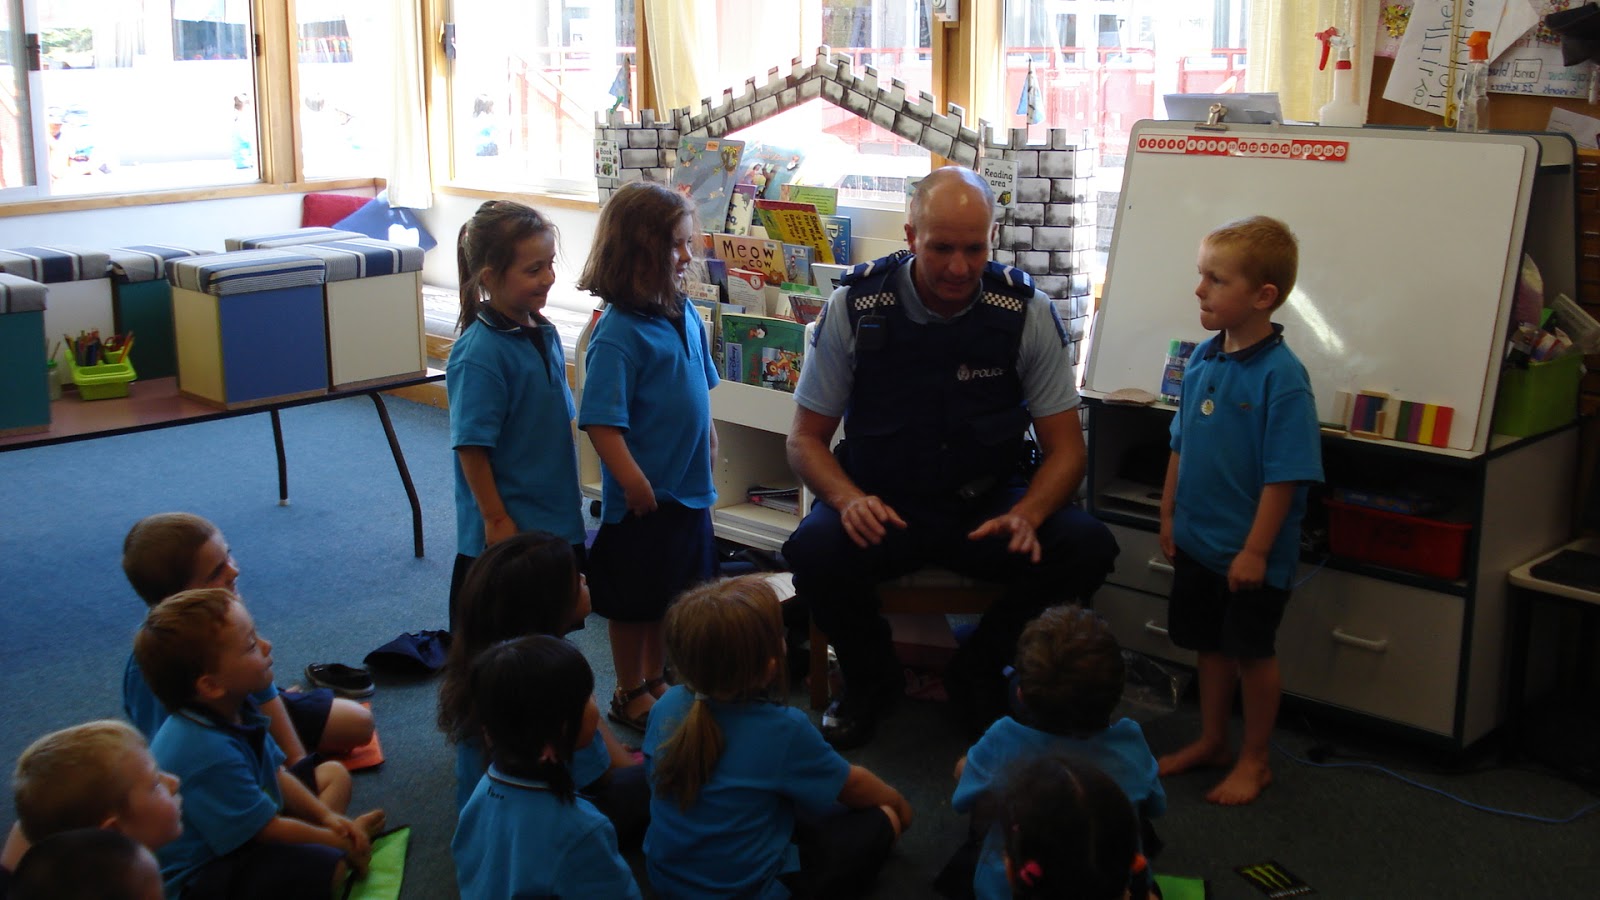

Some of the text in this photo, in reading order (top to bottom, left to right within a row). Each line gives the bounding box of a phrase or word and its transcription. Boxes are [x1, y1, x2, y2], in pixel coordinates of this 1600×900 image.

[600, 147, 612, 155] Book
[985, 168, 1013, 183] Reading
[990, 180, 1006, 188] area
[723, 239, 775, 261] Meow
[972, 367, 1008, 379] POLICE
